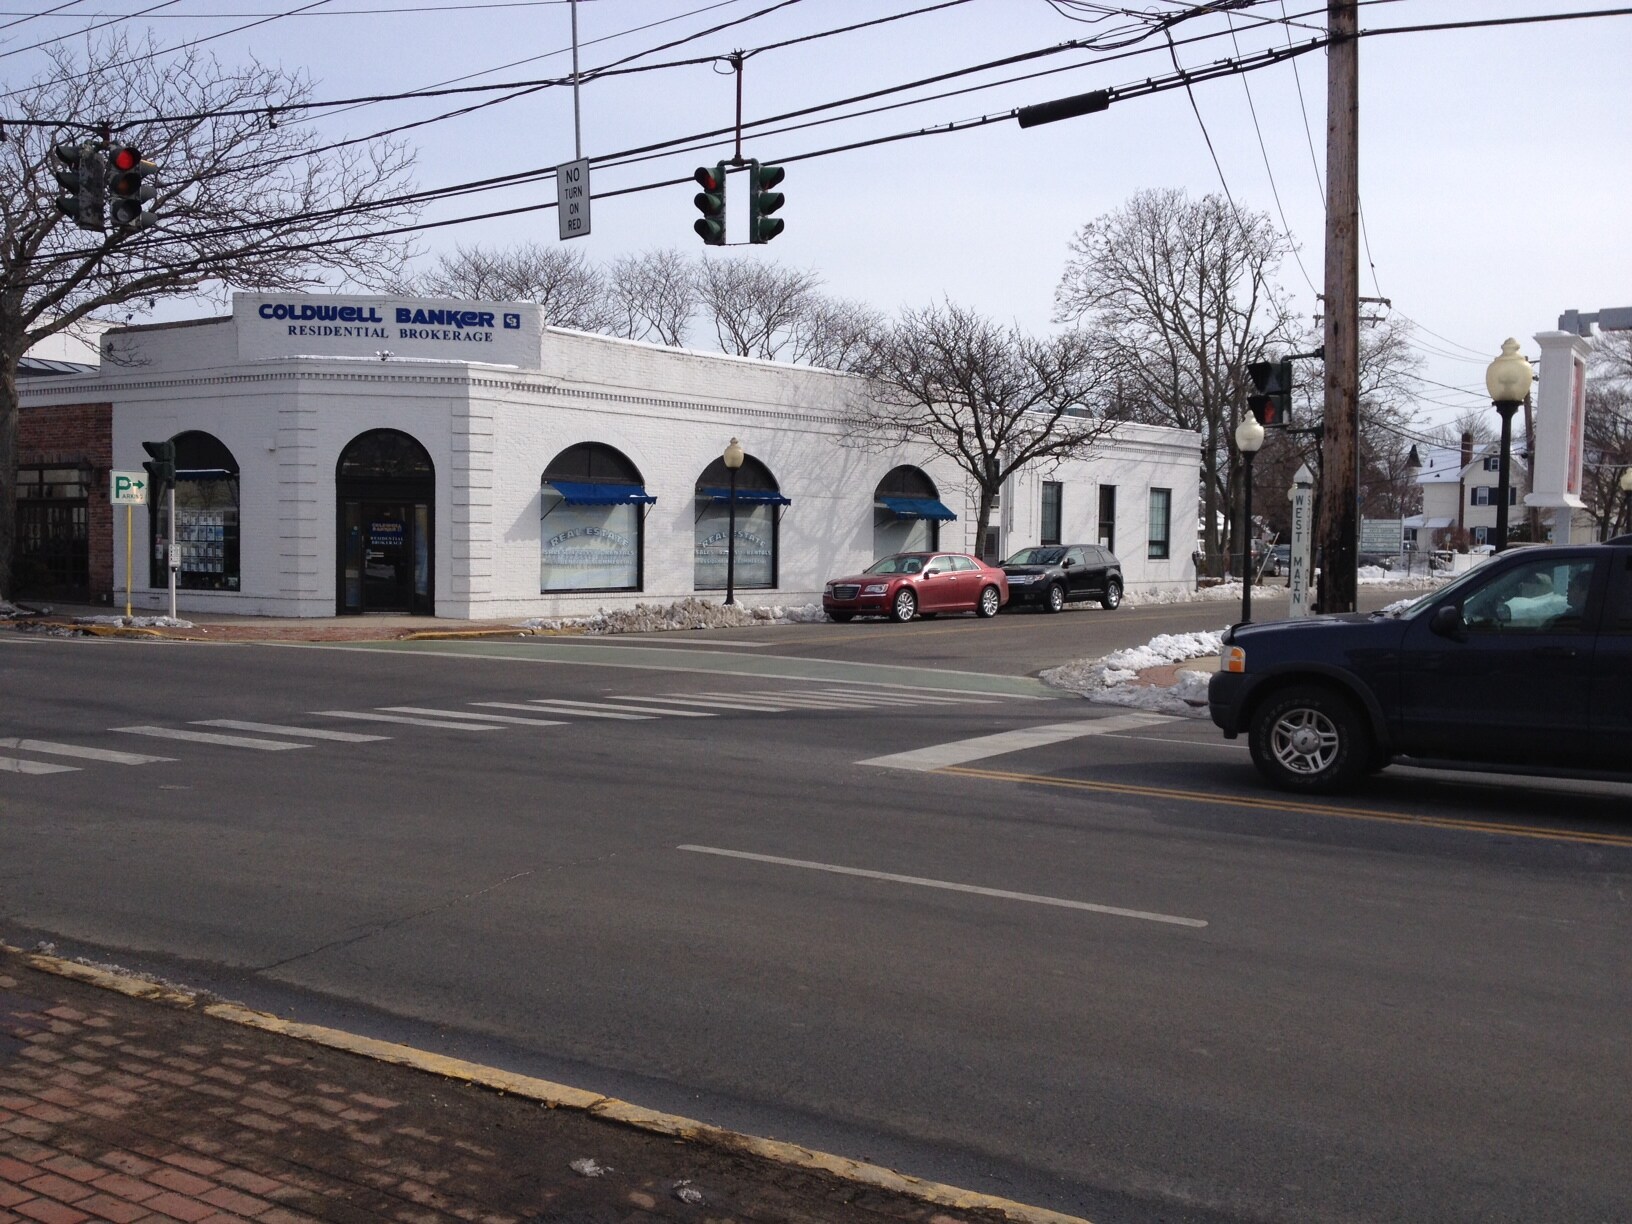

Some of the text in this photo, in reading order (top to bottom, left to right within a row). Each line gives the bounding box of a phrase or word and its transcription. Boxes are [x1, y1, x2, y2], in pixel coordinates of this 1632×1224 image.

[566, 167, 580, 184] NO
[564, 185, 583, 200] TURN
[569, 203, 579, 215] ON
[567, 218, 582, 231] RED
[258, 303, 383, 323] COLDWELL
[395, 307, 495, 329] BANKER
[288, 325, 493, 342] RESIDENTIAL BROKERAGE
[550, 527, 629, 547] REAL ESTATE
[702, 532, 727, 548] REAL
[1293, 495, 1304, 604] WEST MAIN
